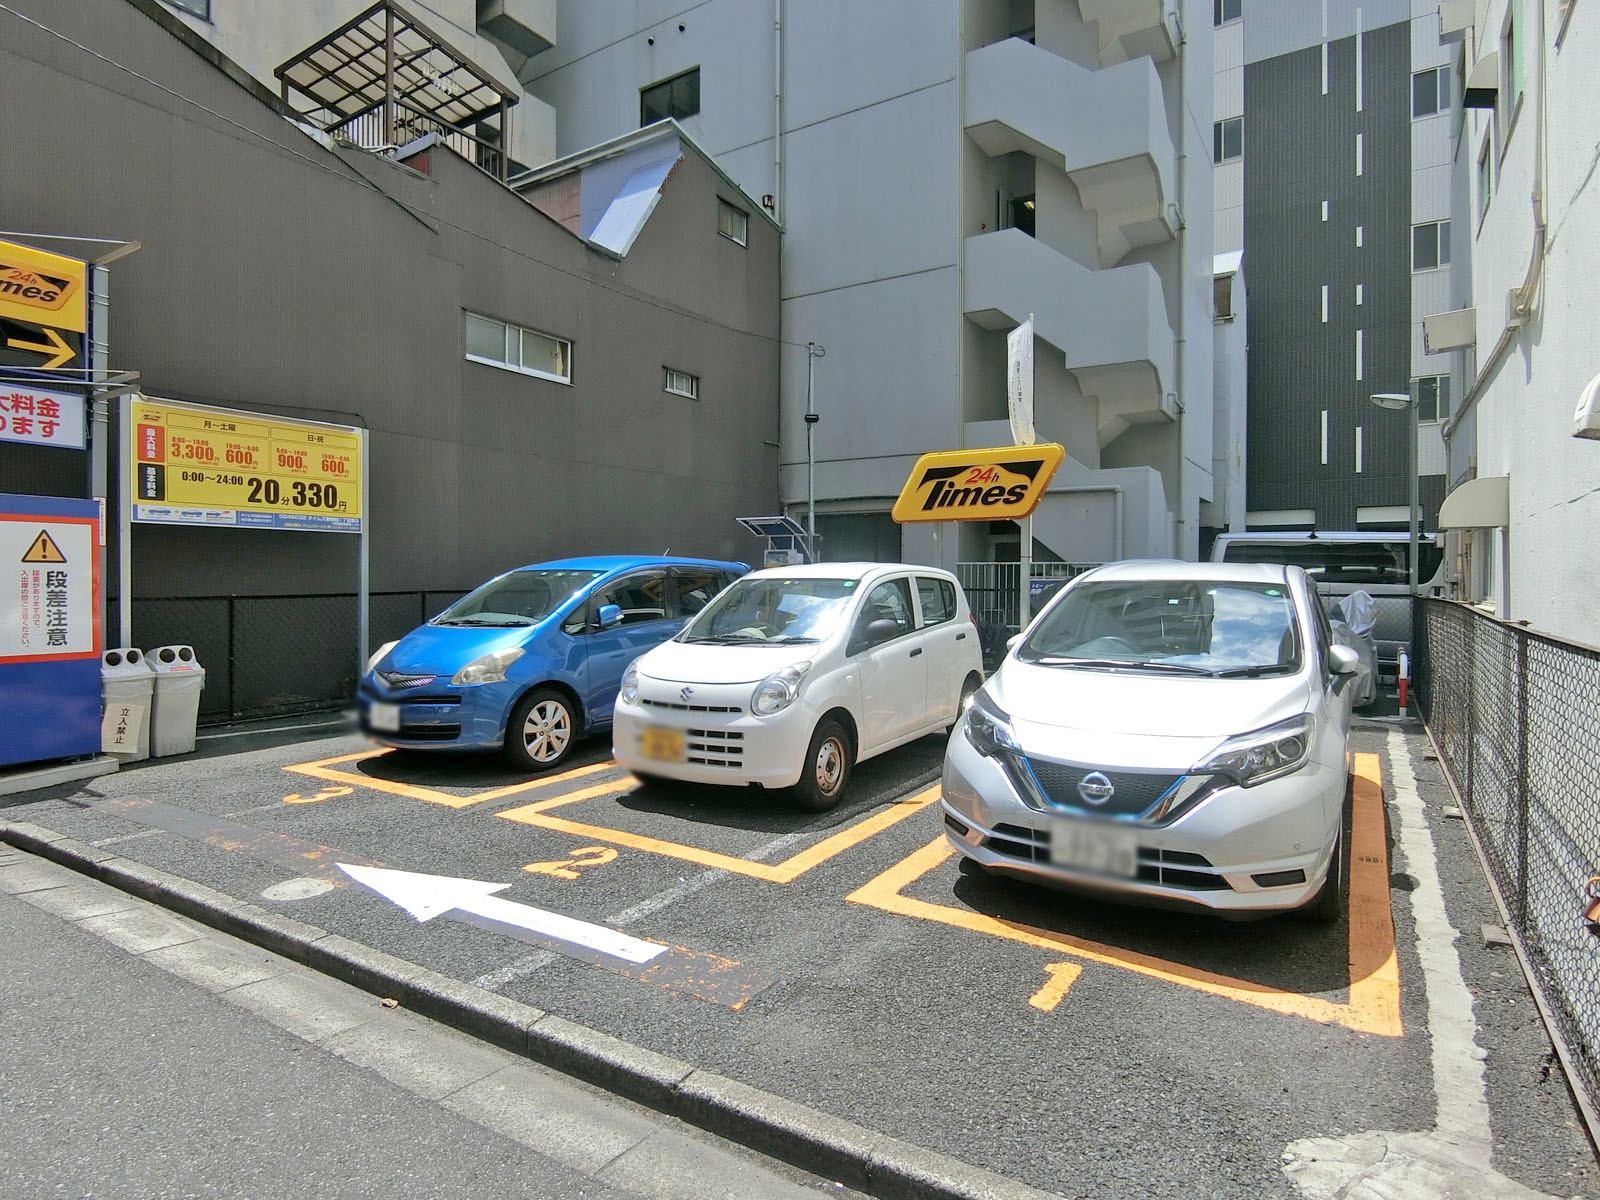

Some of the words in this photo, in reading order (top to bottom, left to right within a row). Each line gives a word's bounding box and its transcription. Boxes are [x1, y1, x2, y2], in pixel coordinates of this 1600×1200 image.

[0, 280, 59, 302] mes
[8, 271, 37, 285] 24h
[965, 467, 1000, 484] 24h
[921, 480, 1029, 511] Times
[46, 570, 68, 646] 段差注意
[114, 708, 130, 744] 立入禁止
[282, 786, 355, 805] 3
[521, 846, 619, 880] 2
[1028, 961, 1083, 1012] 1
